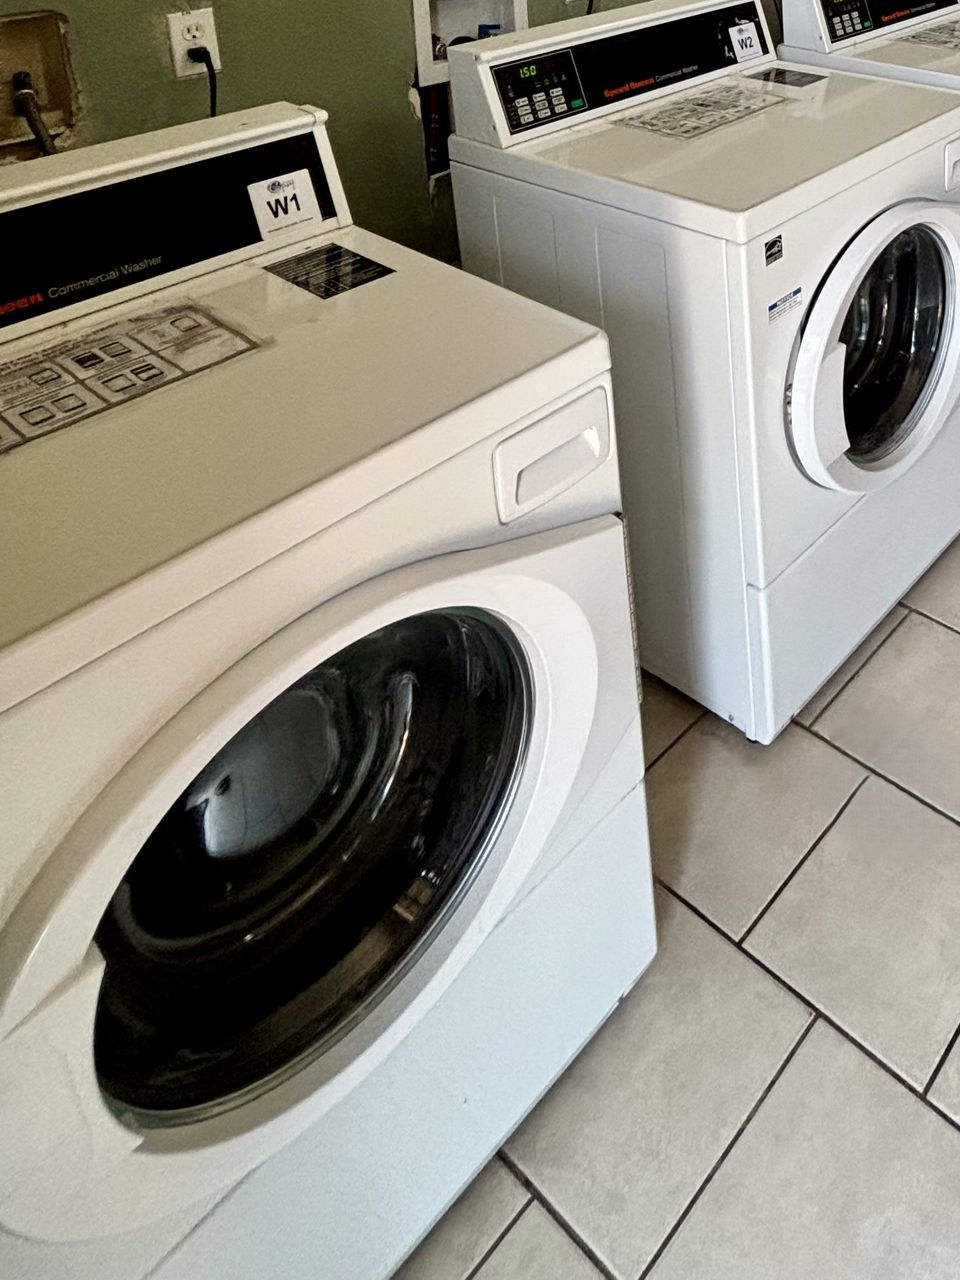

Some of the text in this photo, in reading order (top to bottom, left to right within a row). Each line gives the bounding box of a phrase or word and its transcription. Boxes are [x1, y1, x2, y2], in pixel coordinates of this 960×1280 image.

[737, 36, 754, 50] W2
[266, 193, 301, 218] W1
[48, 269, 119, 298] Commercial
[120, 256, 162, 275] Washer
